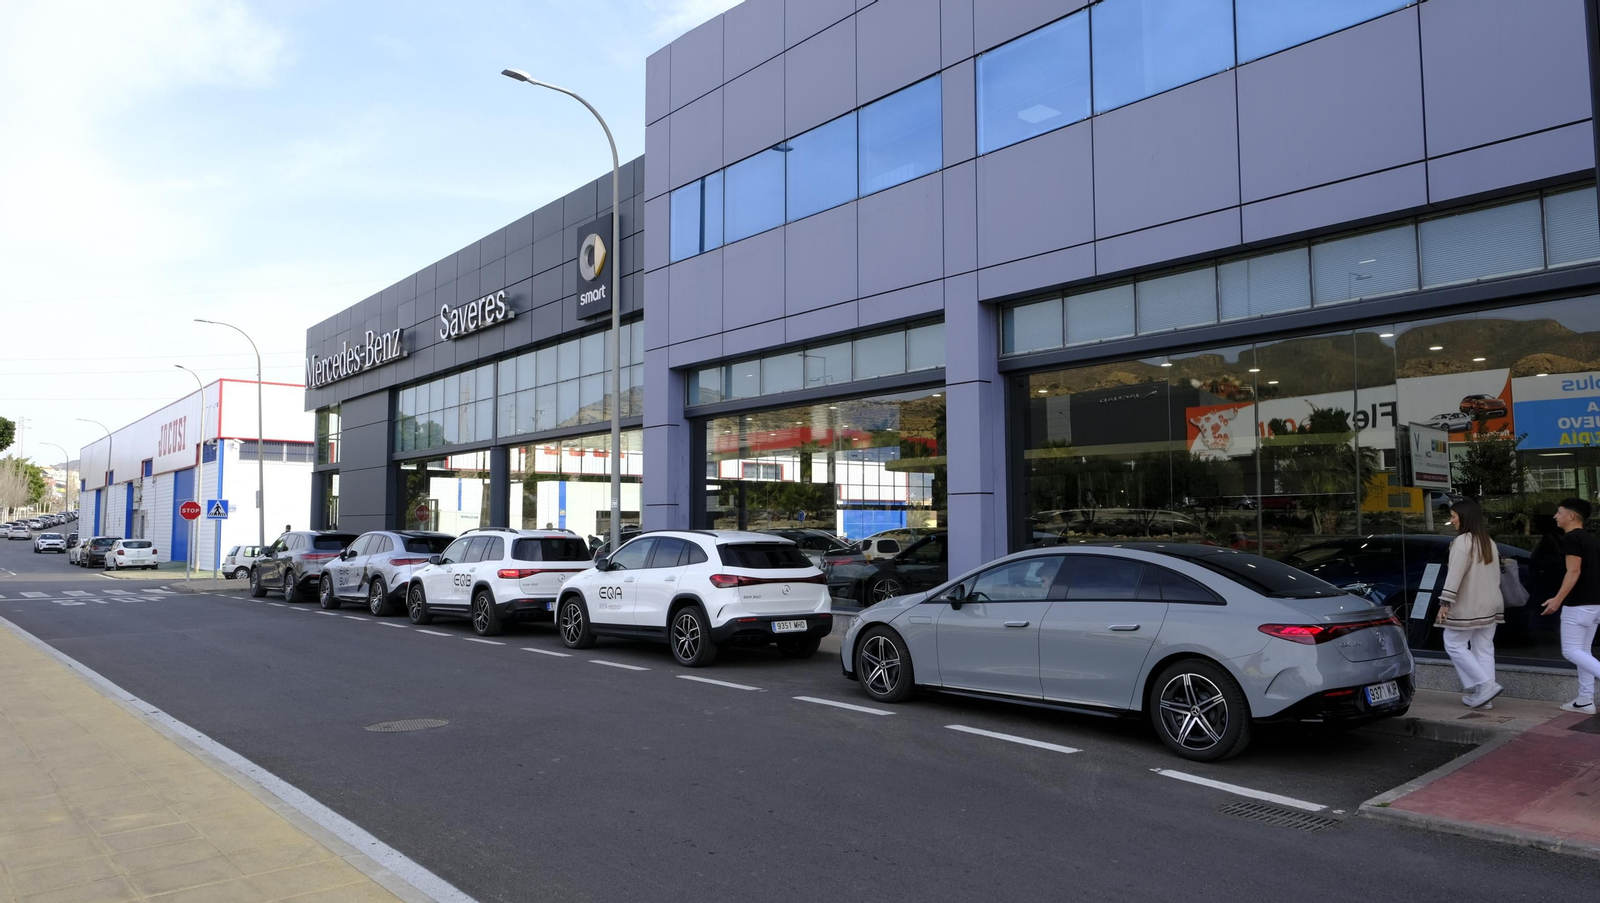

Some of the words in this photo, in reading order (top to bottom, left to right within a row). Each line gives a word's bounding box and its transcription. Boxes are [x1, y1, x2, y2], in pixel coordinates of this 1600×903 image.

[580, 284, 606, 306] smart
[440, 290, 506, 341] Saveres
[305, 328, 401, 389] Mercedes-Benz
[454, 573, 471, 587] EQB
[599, 586, 622, 600] EQA
[51, 596, 166, 606] STOP
[776, 622, 792, 630] 9351
[1370, 685, 1387, 701] 9371
